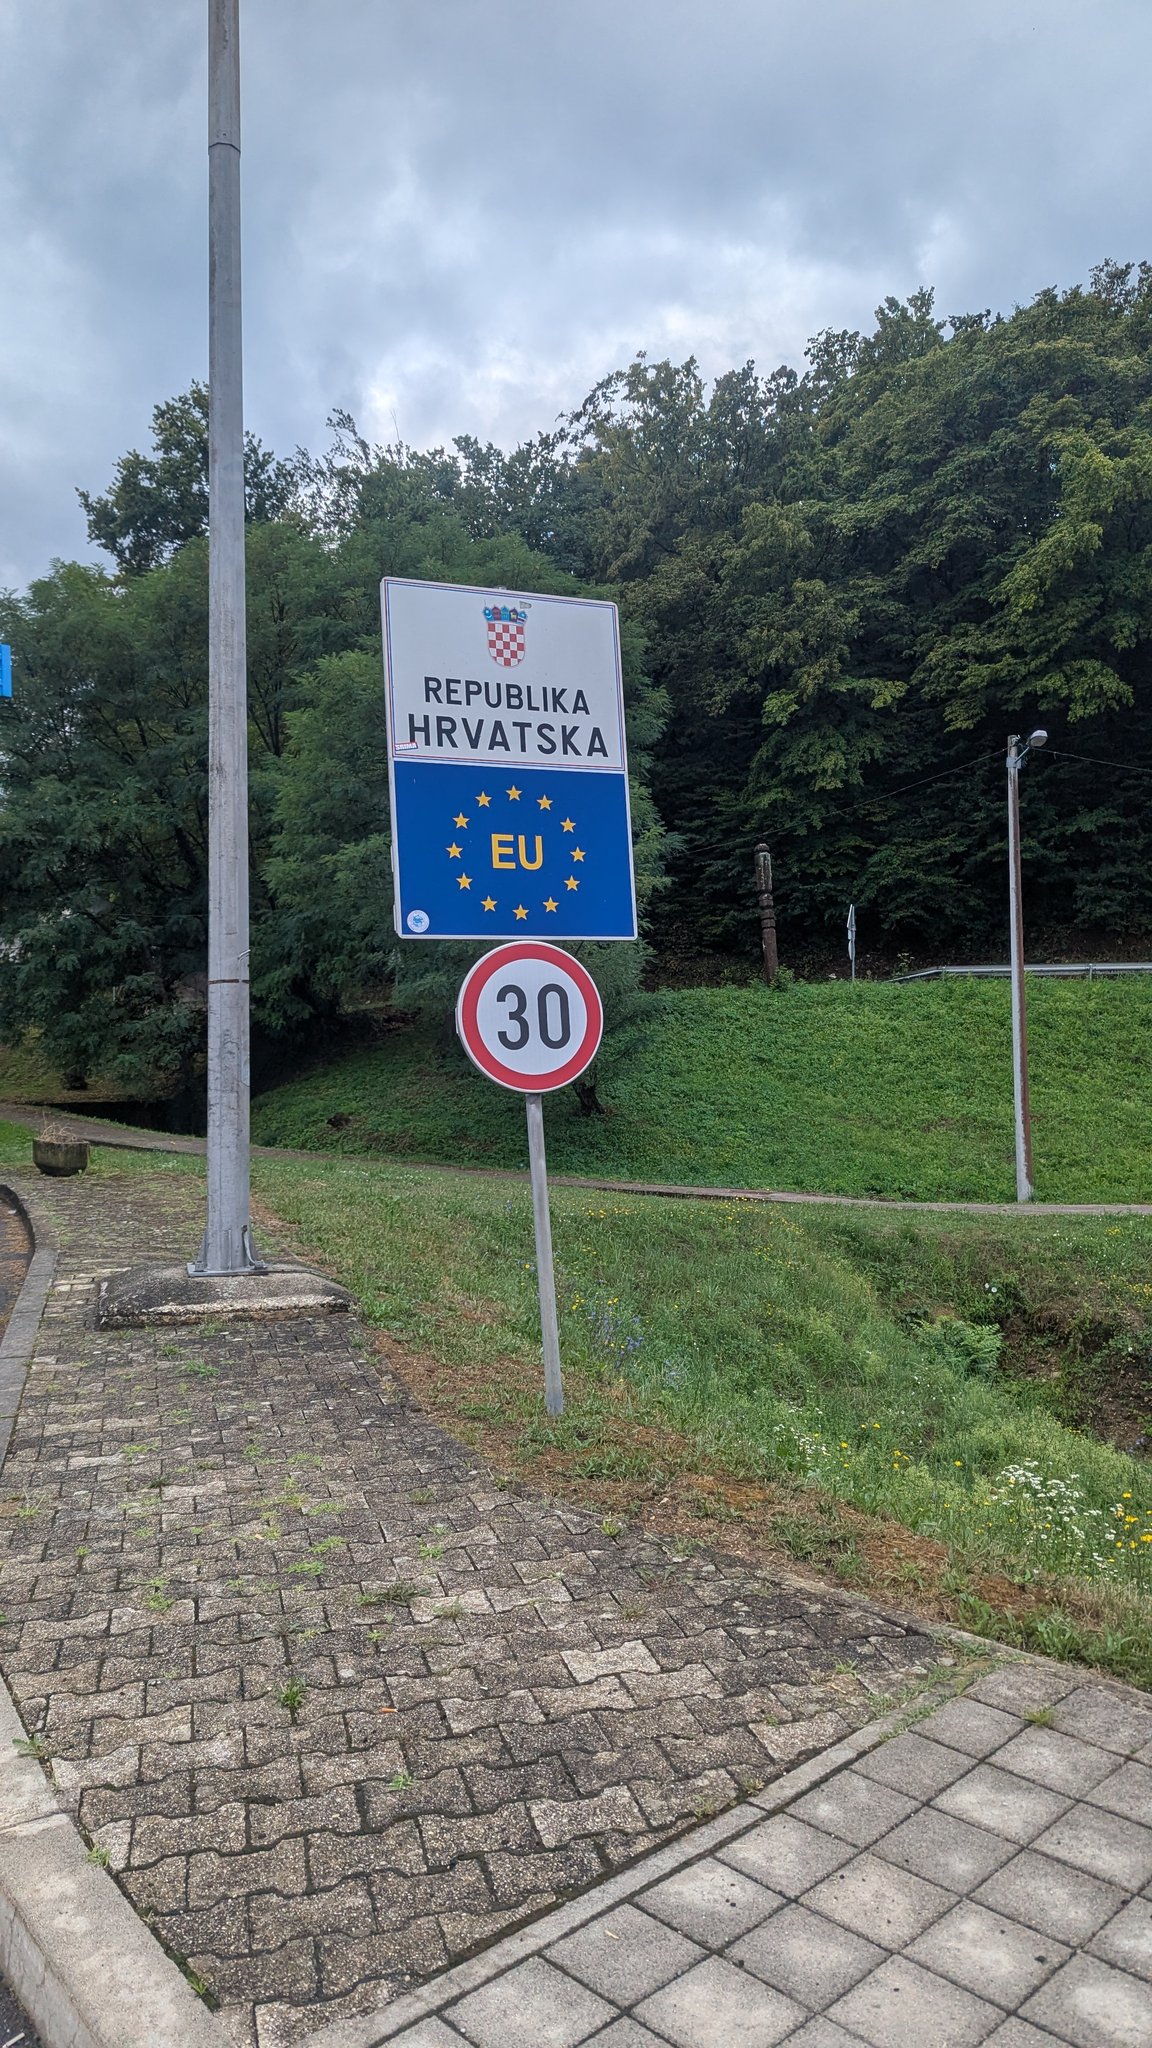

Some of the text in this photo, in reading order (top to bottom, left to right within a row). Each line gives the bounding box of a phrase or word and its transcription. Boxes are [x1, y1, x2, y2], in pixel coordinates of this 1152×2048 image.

[424, 677, 590, 715] REPUBLIKA
[408, 713, 609, 757] HRVATSKA
[491, 834, 543, 870] EU
[497, 984, 571, 1051] 30
